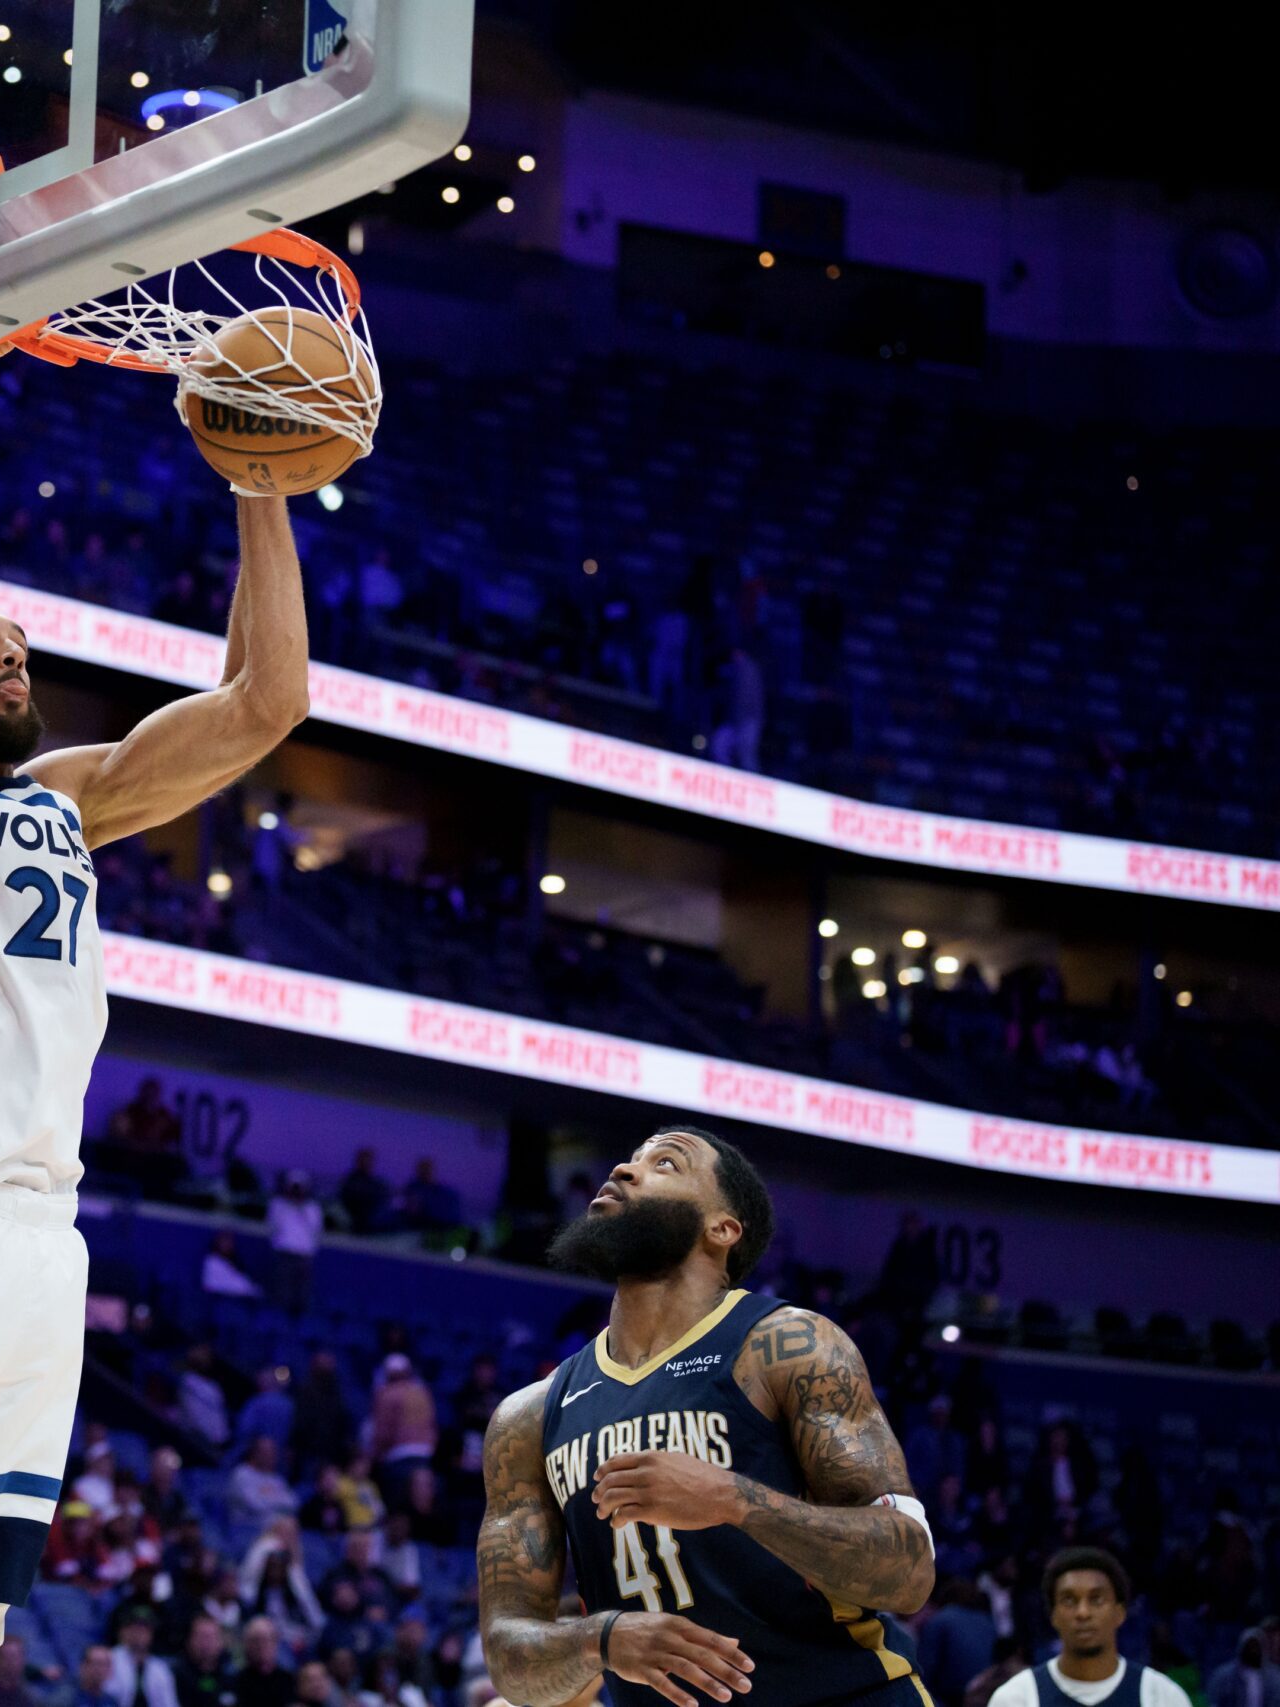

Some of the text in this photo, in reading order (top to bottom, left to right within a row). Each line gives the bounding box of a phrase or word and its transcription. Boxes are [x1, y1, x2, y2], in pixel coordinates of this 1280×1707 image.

[1128, 851, 1226, 893] ROUSES
[3, 865, 90, 968] 27
[1081, 1142, 1211, 1186] MARKETS
[665, 1354, 722, 1372] NEWAGE
[673, 1365, 709, 1378] GARAGE
